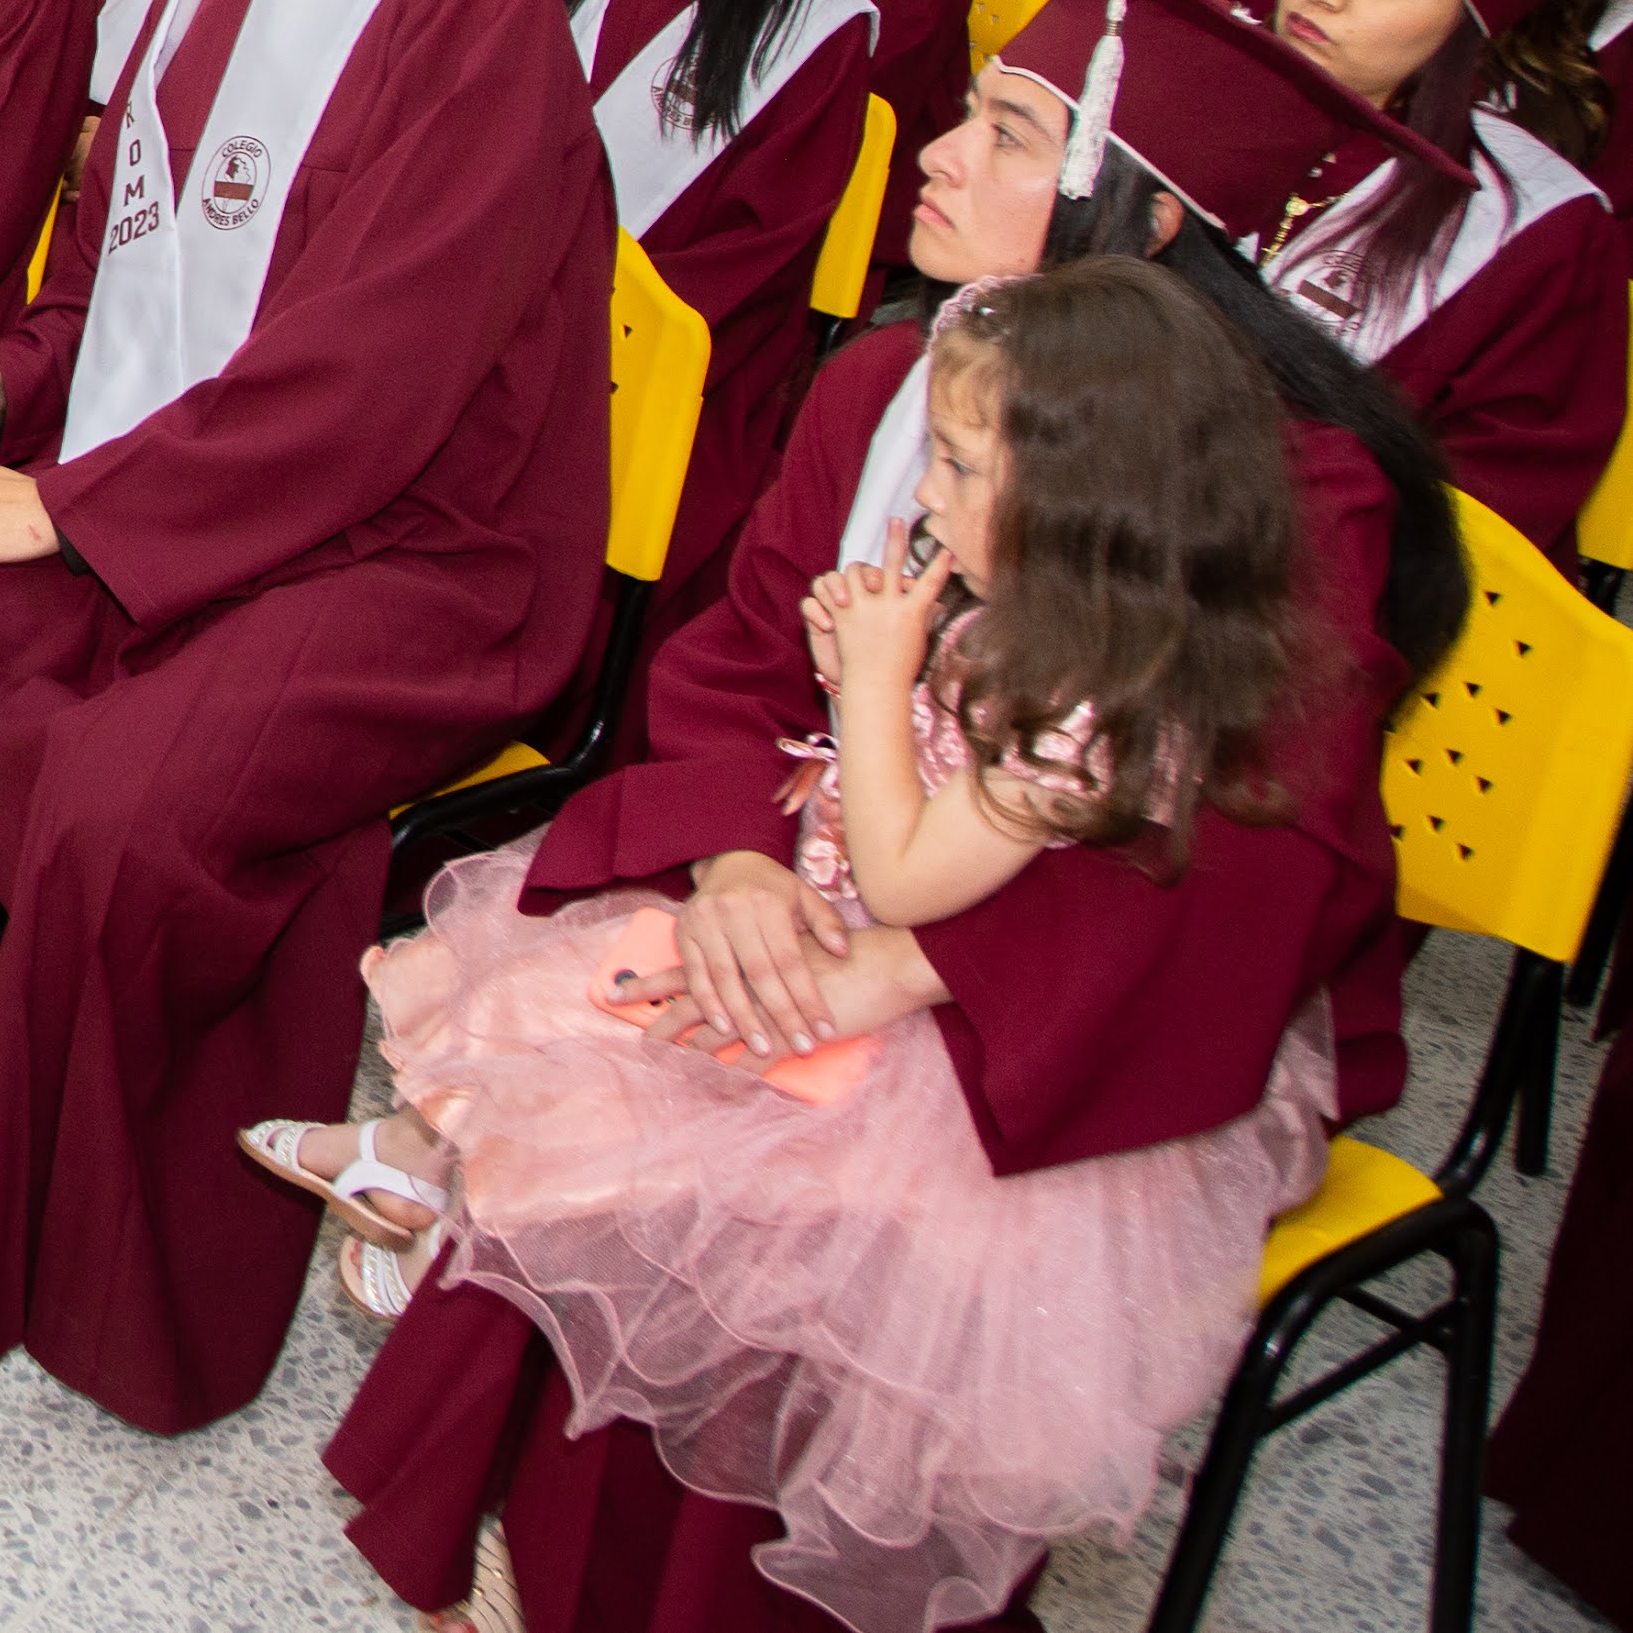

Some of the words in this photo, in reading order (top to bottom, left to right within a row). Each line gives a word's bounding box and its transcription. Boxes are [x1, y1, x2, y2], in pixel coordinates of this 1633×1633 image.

[123, 100, 145, 207] ROM
[221, 140, 263, 160] COLEGIO
[108, 201, 160, 255] 2023
[202, 197, 231, 227] ANDRES
[231, 198, 260, 227] BELLO
